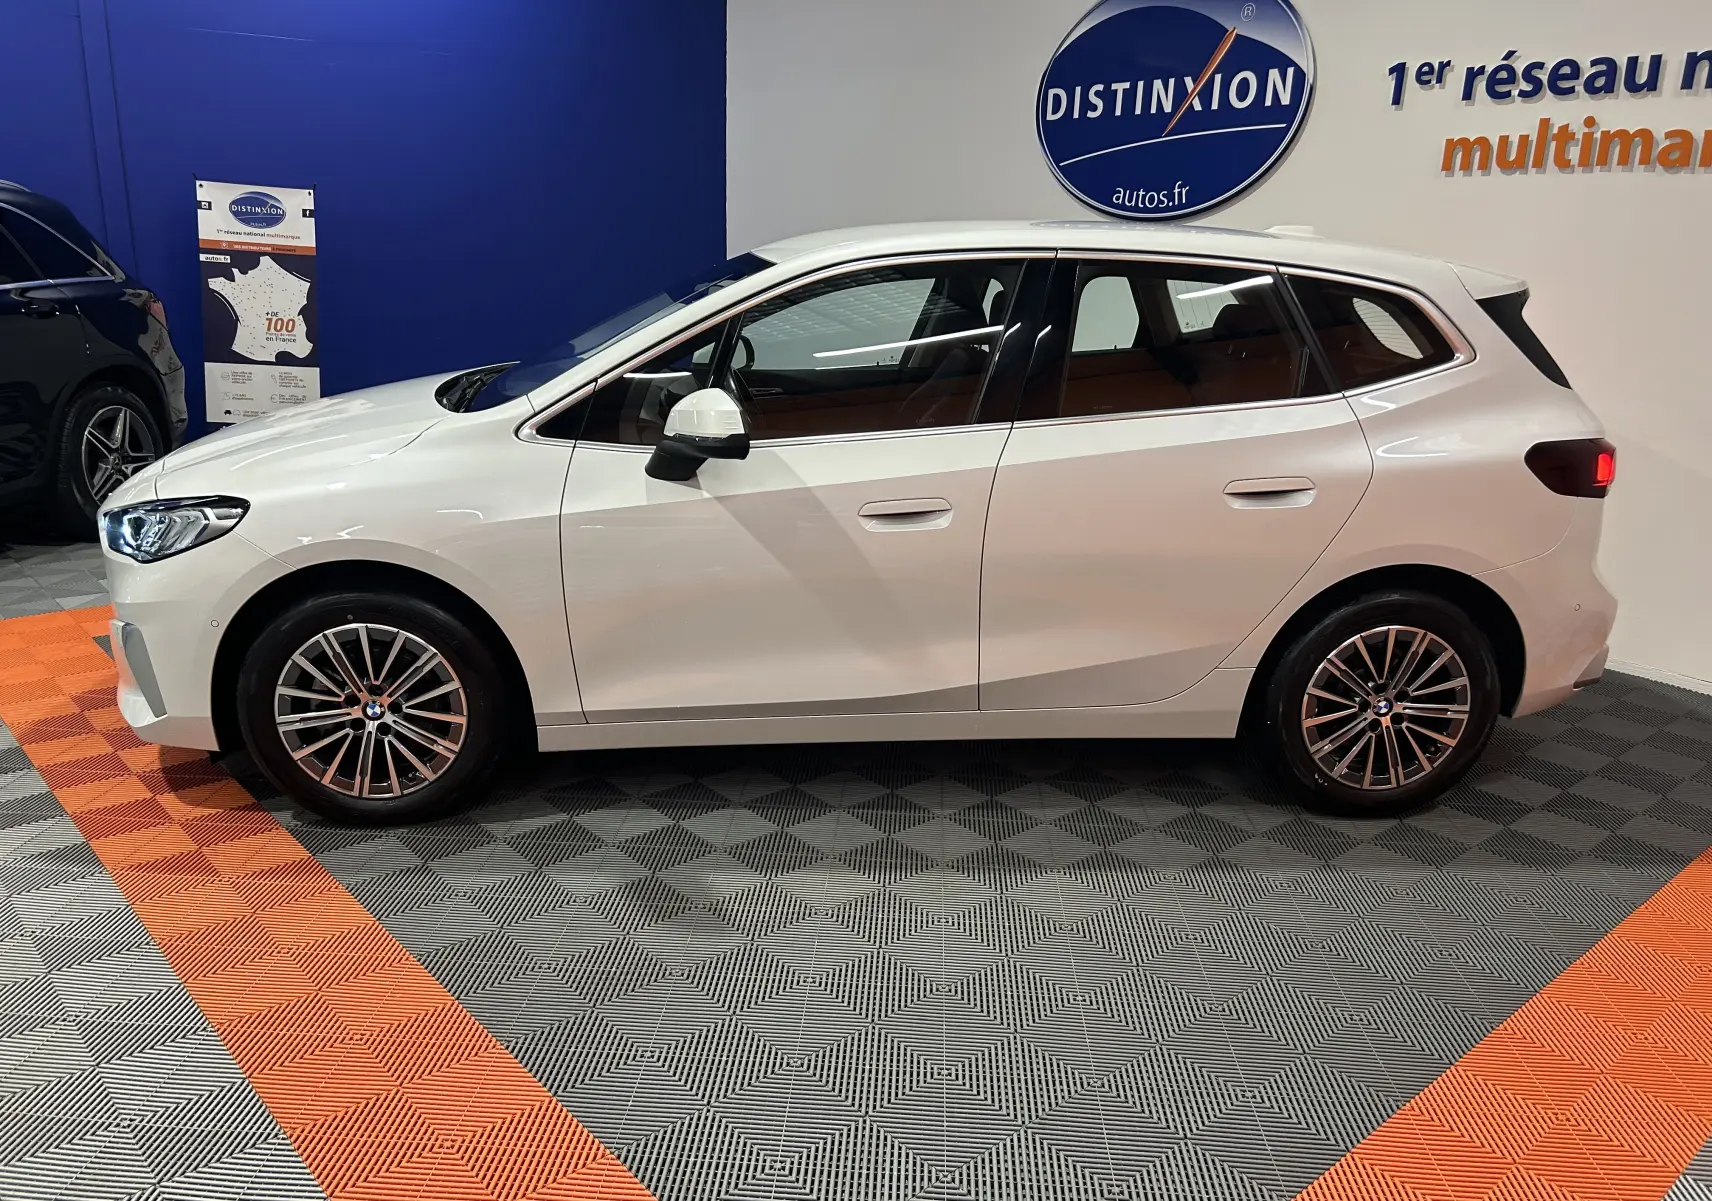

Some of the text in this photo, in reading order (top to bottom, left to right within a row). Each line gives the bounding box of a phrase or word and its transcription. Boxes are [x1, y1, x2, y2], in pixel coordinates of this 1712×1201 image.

[1388, 59, 1452, 107] 1er
[1461, 49, 1664, 102] réseau
[1045, 66, 1296, 121] DISTINXION
[1112, 181, 1190, 208] autos.fr
[231, 204, 284, 215] DISTINXION
[266, 233, 301, 241] multimarque
[266, 318, 296, 333] 100
